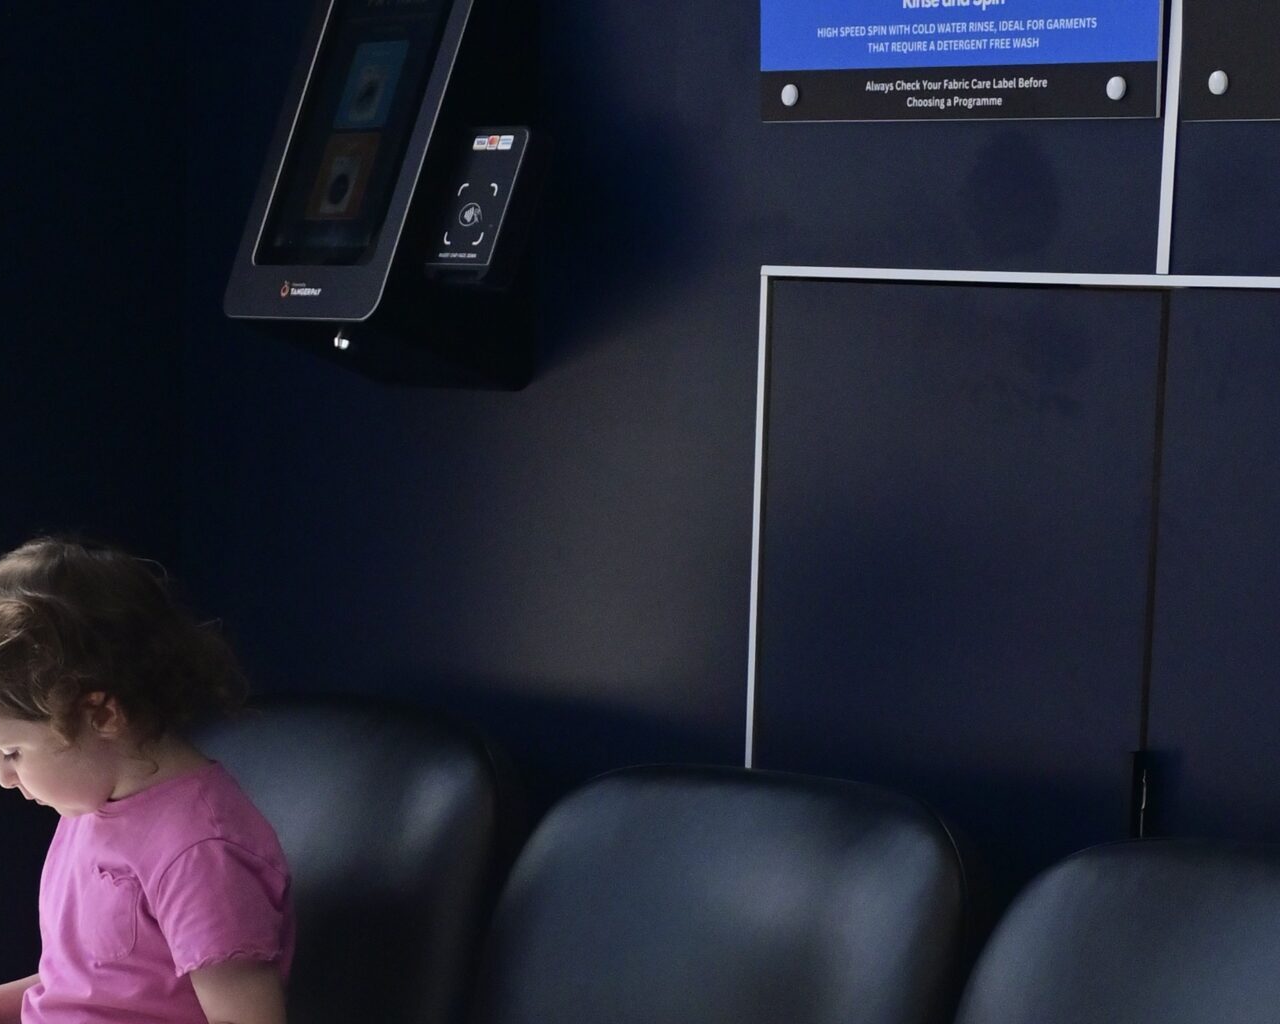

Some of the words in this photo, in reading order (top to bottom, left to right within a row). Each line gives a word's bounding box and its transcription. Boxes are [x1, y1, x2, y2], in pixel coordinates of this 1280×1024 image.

[817, 27, 838, 38] HIGH
[839, 26, 866, 37] SPEED
[867, 25, 887, 36] SPIN
[888, 24, 910, 35] WITH
[912, 23, 936, 35] COLD
[937, 22, 967, 34] WATER
[968, 21, 998, 34] RINSE,
[999, 20, 1025, 32] IDEAL
[1026, 19, 1045, 31] FOR
[1046, 17, 1098, 30] GARMENTS
[867, 42, 889, 53] THAT
[891, 41, 928, 54] REQUIRE
[928, 41, 936, 51] A
[937, 39, 988, 51] DETERGENT
[989, 38, 1011, 50] FREE
[1012, 37, 1040, 48] WASH
[865, 80, 894, 94] Always
[895, 80, 921, 91] Check
[922, 79, 942, 91] Your
[943, 79, 970, 90] Fabric
[971, 78, 991, 89] Care
[992, 77, 1017, 89] Label
[1018, 77, 1048, 88] Before
[906, 96, 946, 110] Choosing
[953, 96, 1003, 109] Programme
